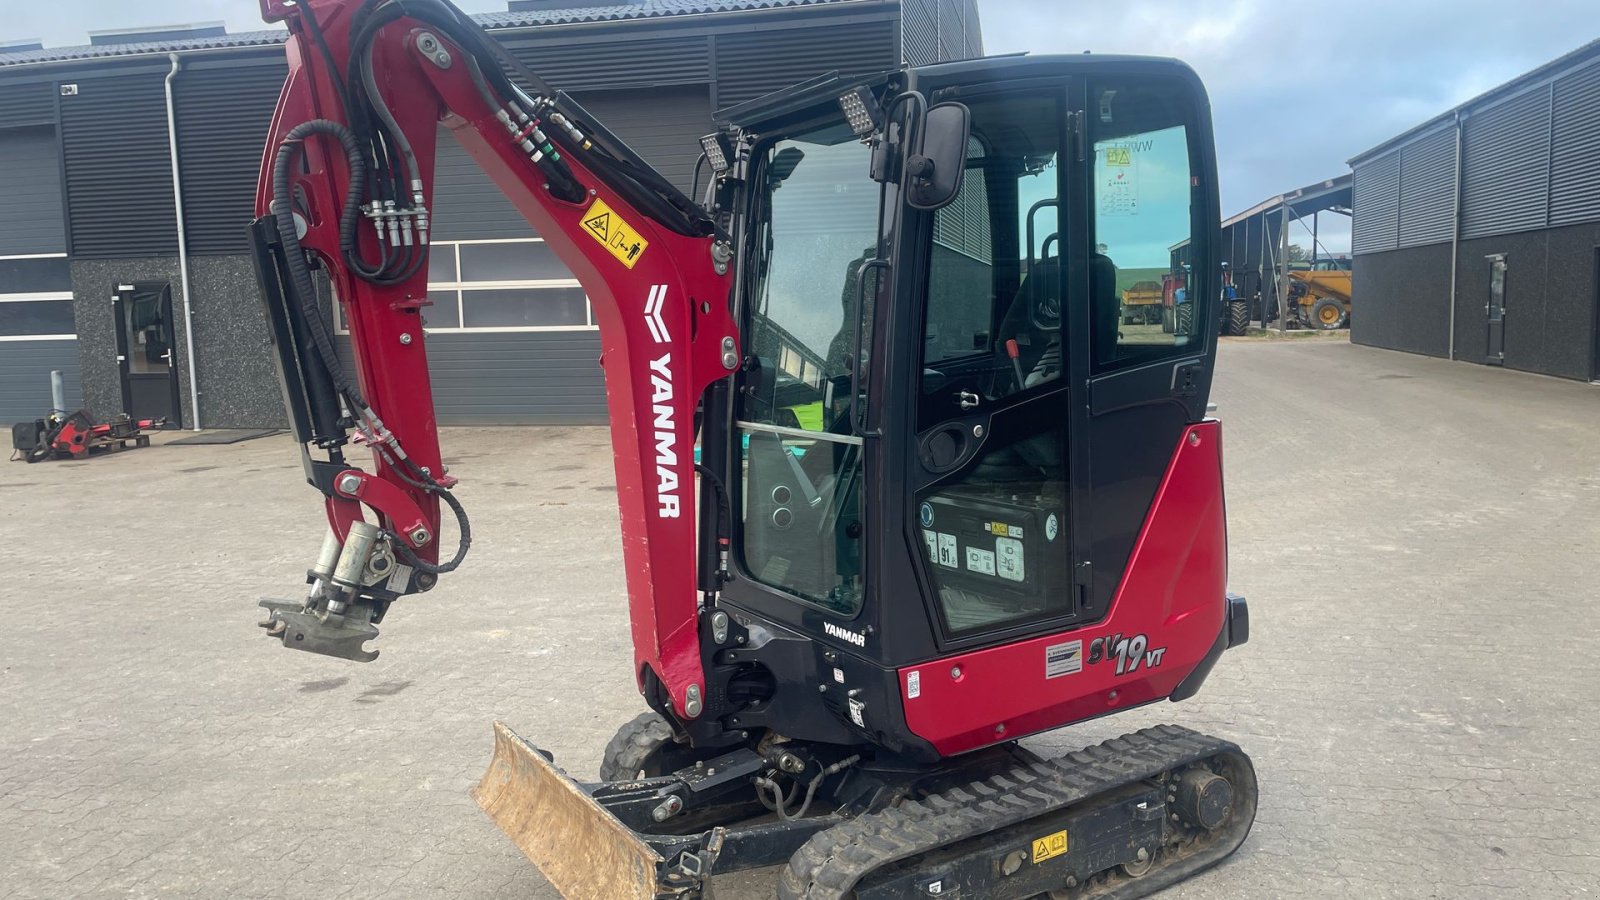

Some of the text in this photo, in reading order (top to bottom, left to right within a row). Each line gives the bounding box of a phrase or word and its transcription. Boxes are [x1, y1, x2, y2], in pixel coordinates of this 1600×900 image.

[649, 352, 681, 520] YANMAR
[941, 547, 950, 563] 91
[823, 621, 865, 648] YANMAR
